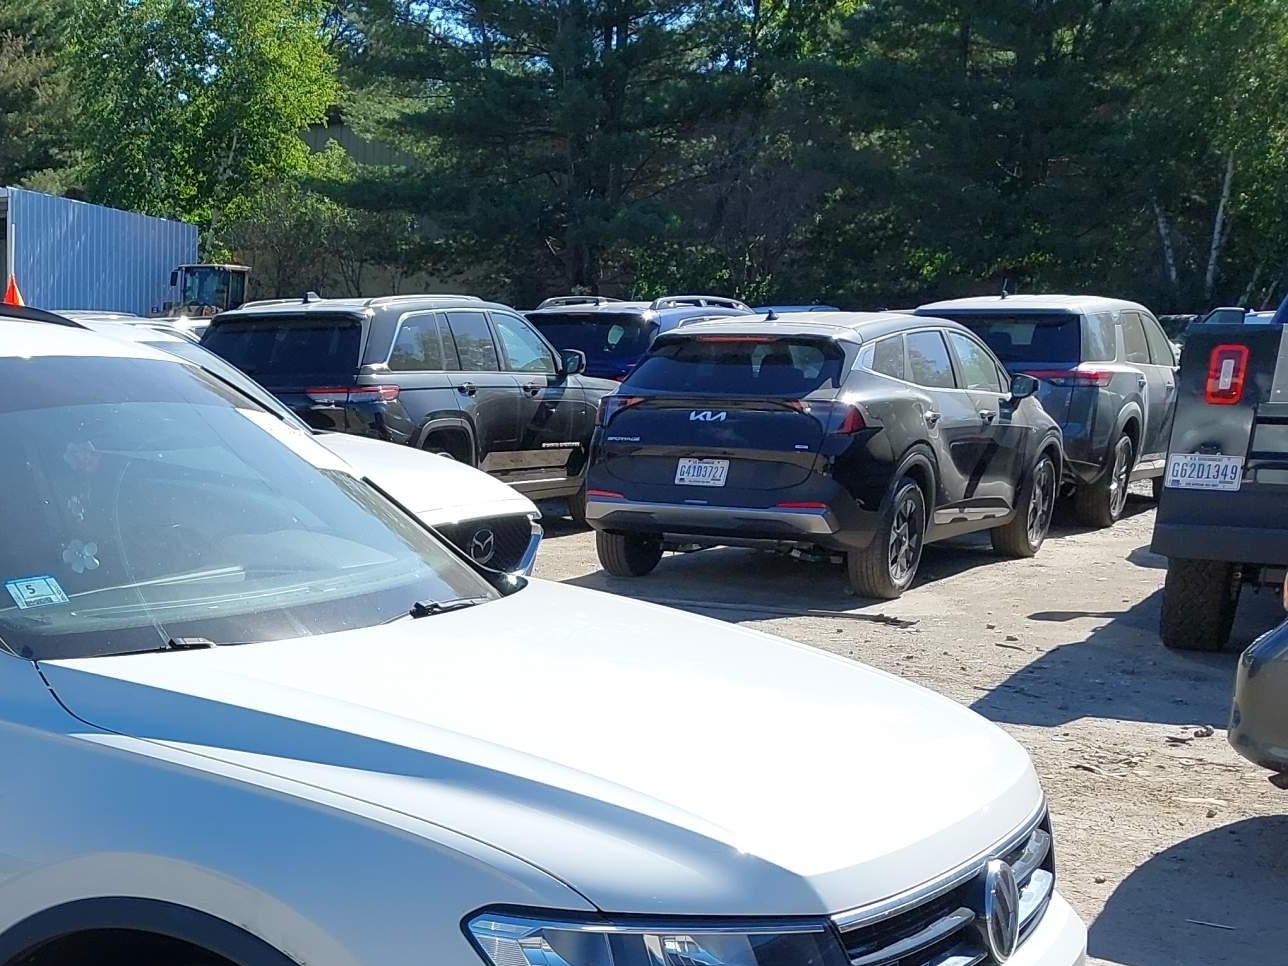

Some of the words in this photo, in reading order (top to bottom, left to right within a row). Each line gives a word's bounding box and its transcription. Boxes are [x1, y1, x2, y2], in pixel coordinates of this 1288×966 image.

[689, 411, 727, 421] KIA
[1171, 462, 1238, 480] G62D1349
[25, 584, 36, 594] 5
